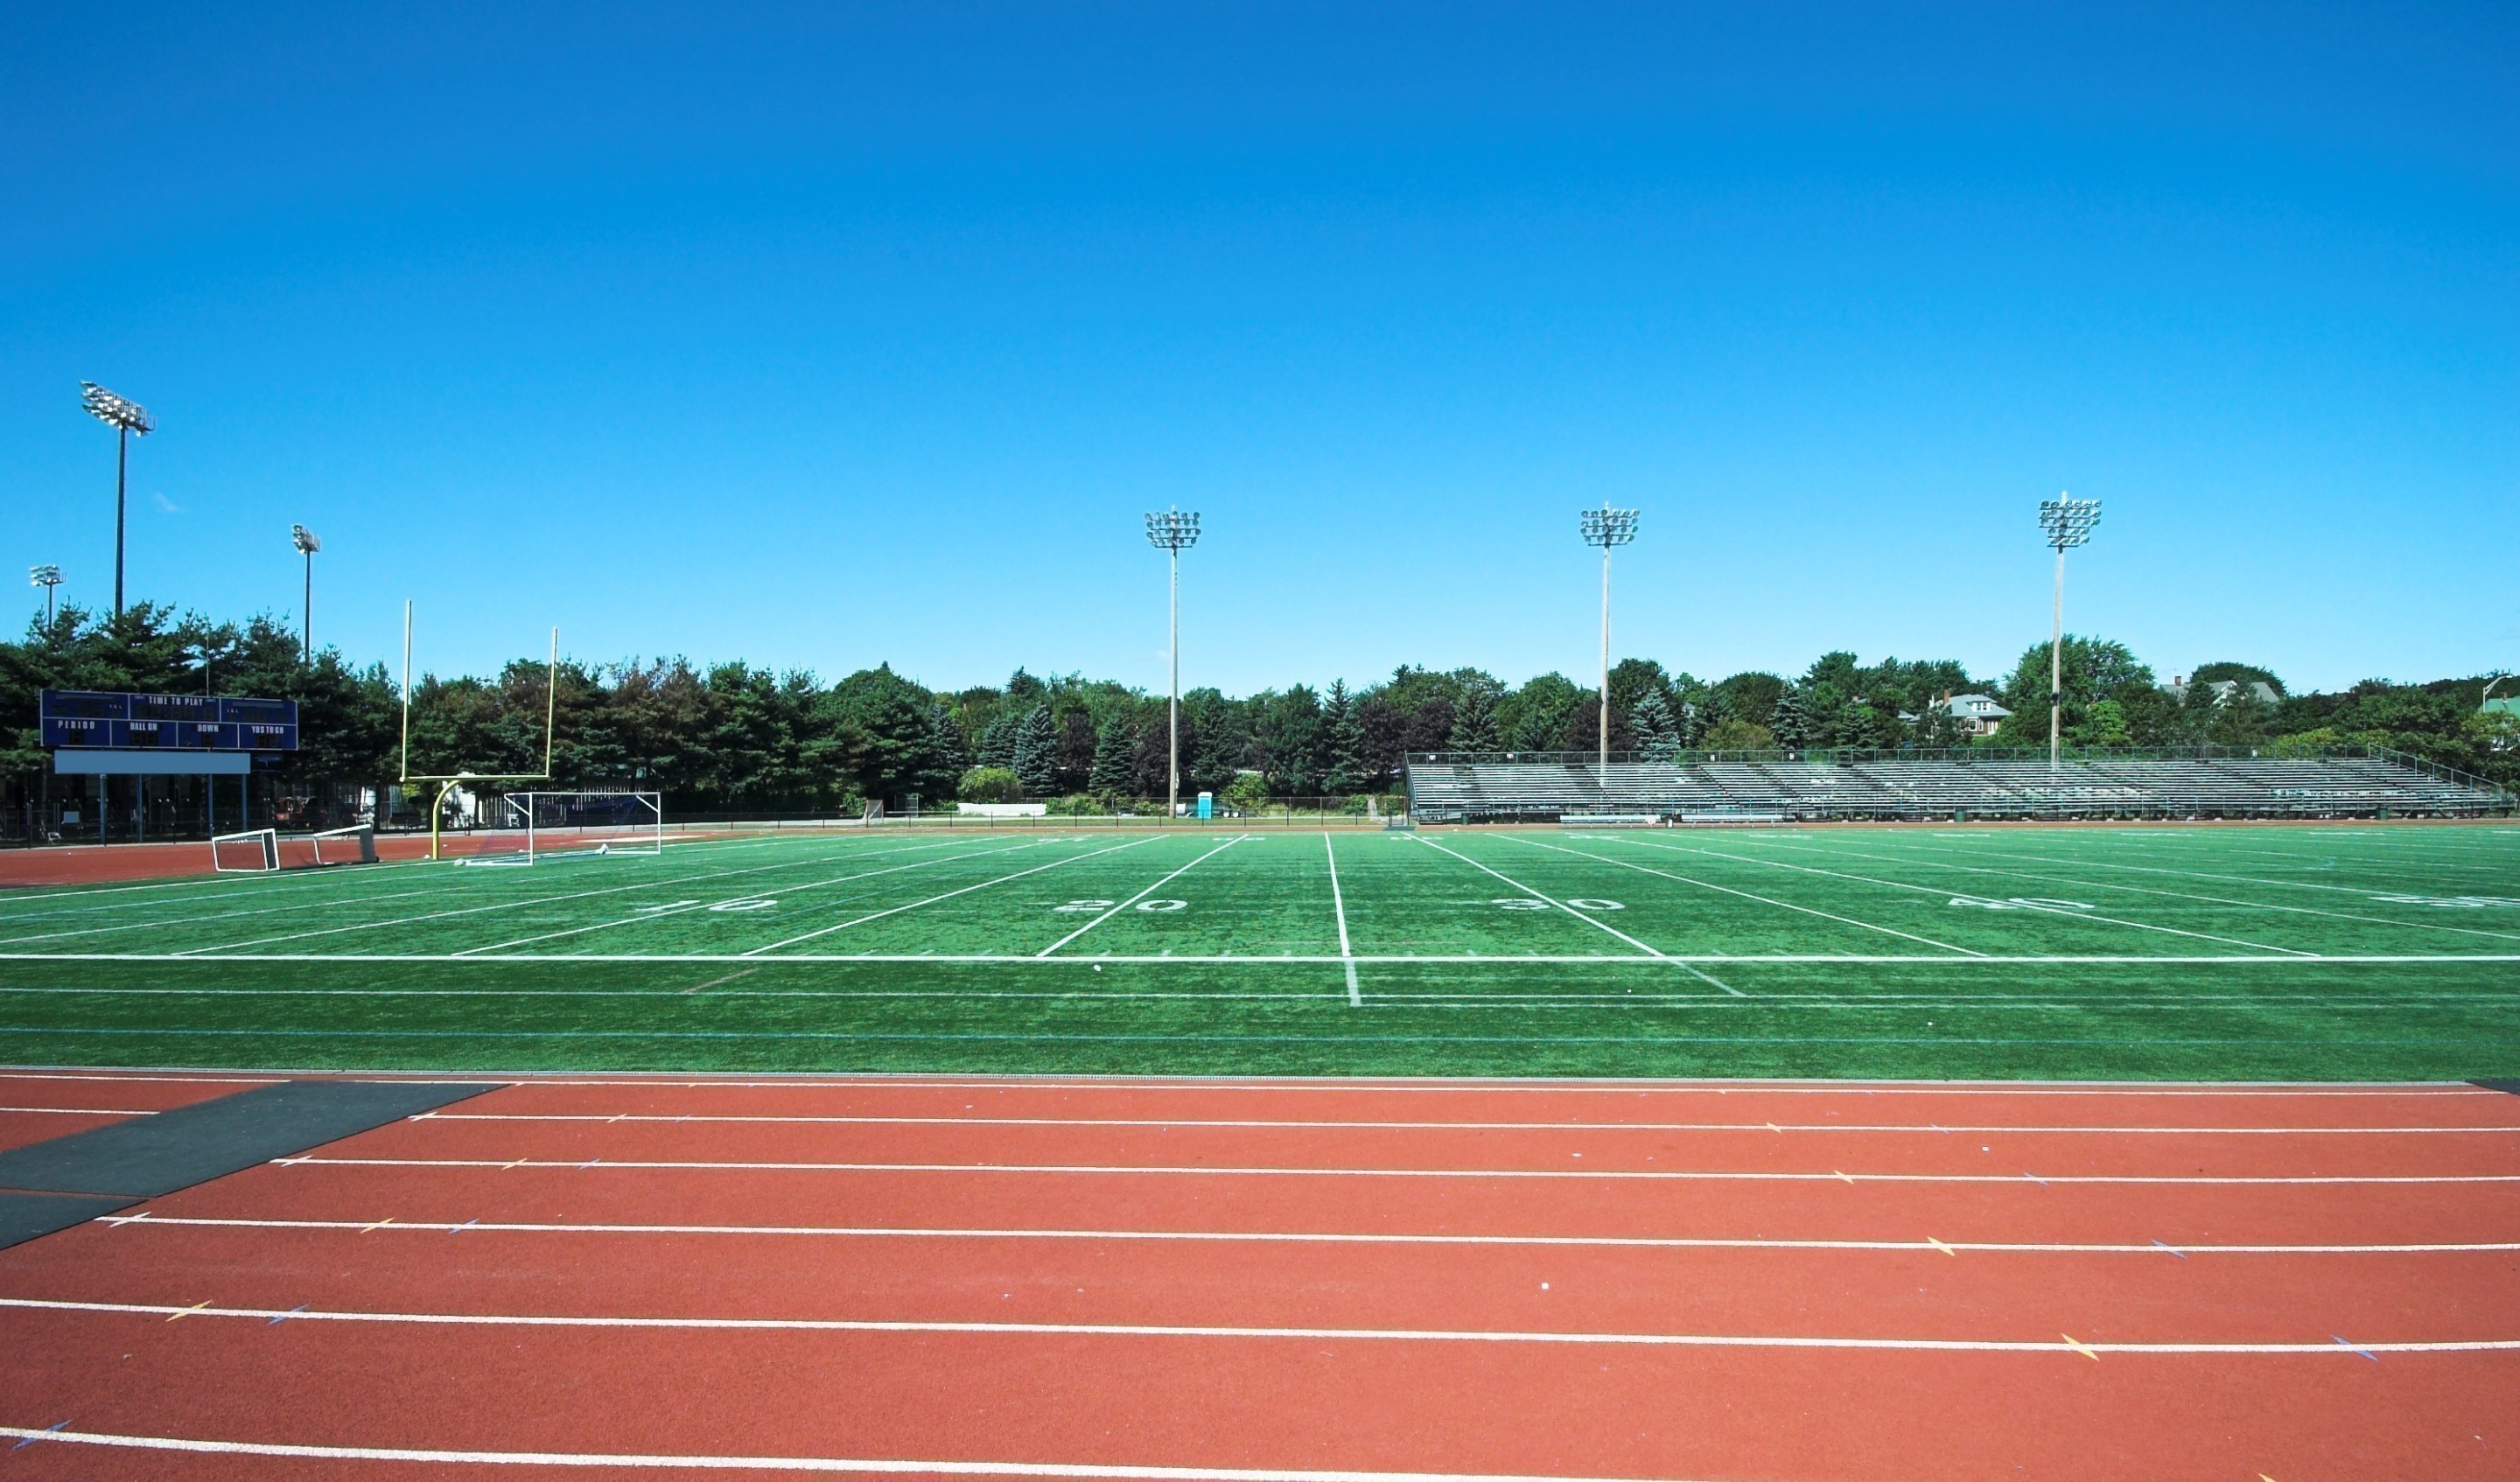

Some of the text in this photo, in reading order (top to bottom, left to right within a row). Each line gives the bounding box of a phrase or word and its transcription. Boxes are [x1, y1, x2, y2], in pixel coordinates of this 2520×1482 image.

[149, 696, 168, 705] TIME
[58, 720, 95, 730] PERIOD
[130, 722, 146, 731] BALL
[197, 724, 219, 733] DOWN
